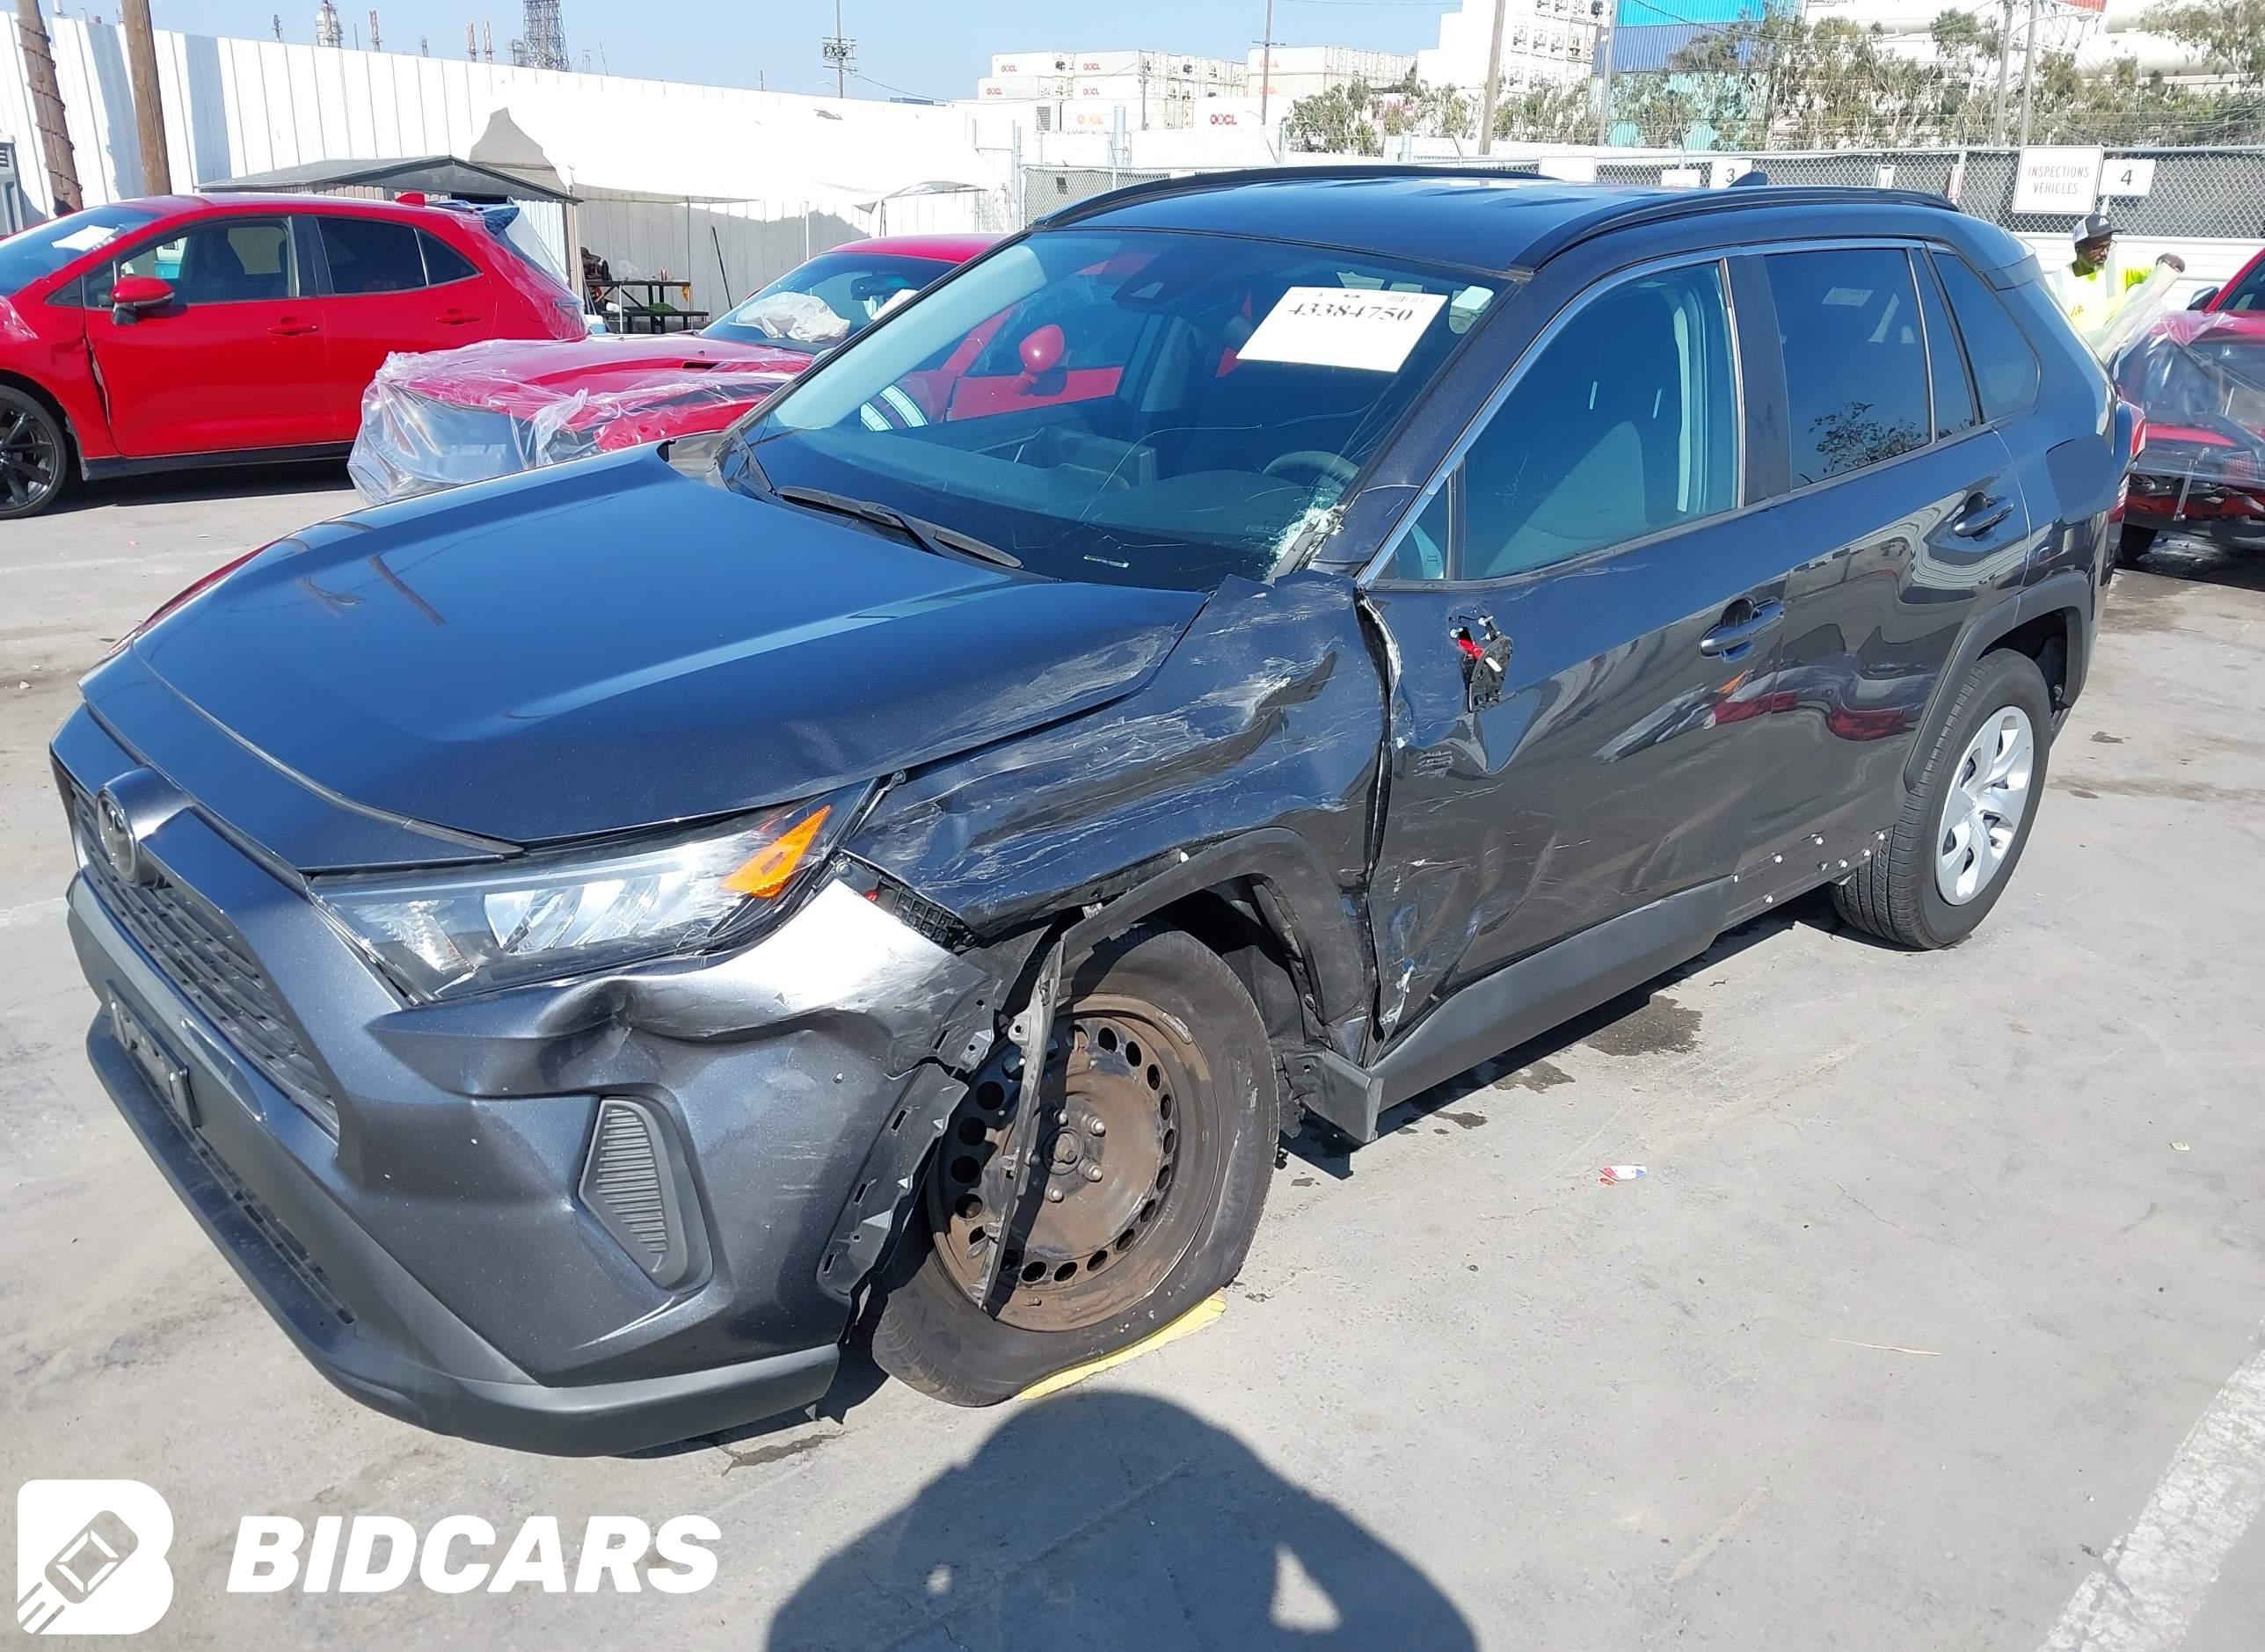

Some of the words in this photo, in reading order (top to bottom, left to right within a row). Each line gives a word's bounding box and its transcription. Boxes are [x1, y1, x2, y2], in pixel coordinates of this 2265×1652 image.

[1210, 114, 1237, 125] OOCL
[1725, 167, 1736, 183] 3
[2028, 165, 2090, 178] INSPECTIONS
[2120, 169, 2133, 186] 4
[2034, 182, 2079, 194] VEHICLES
[1288, 302, 1413, 322] 43384750
